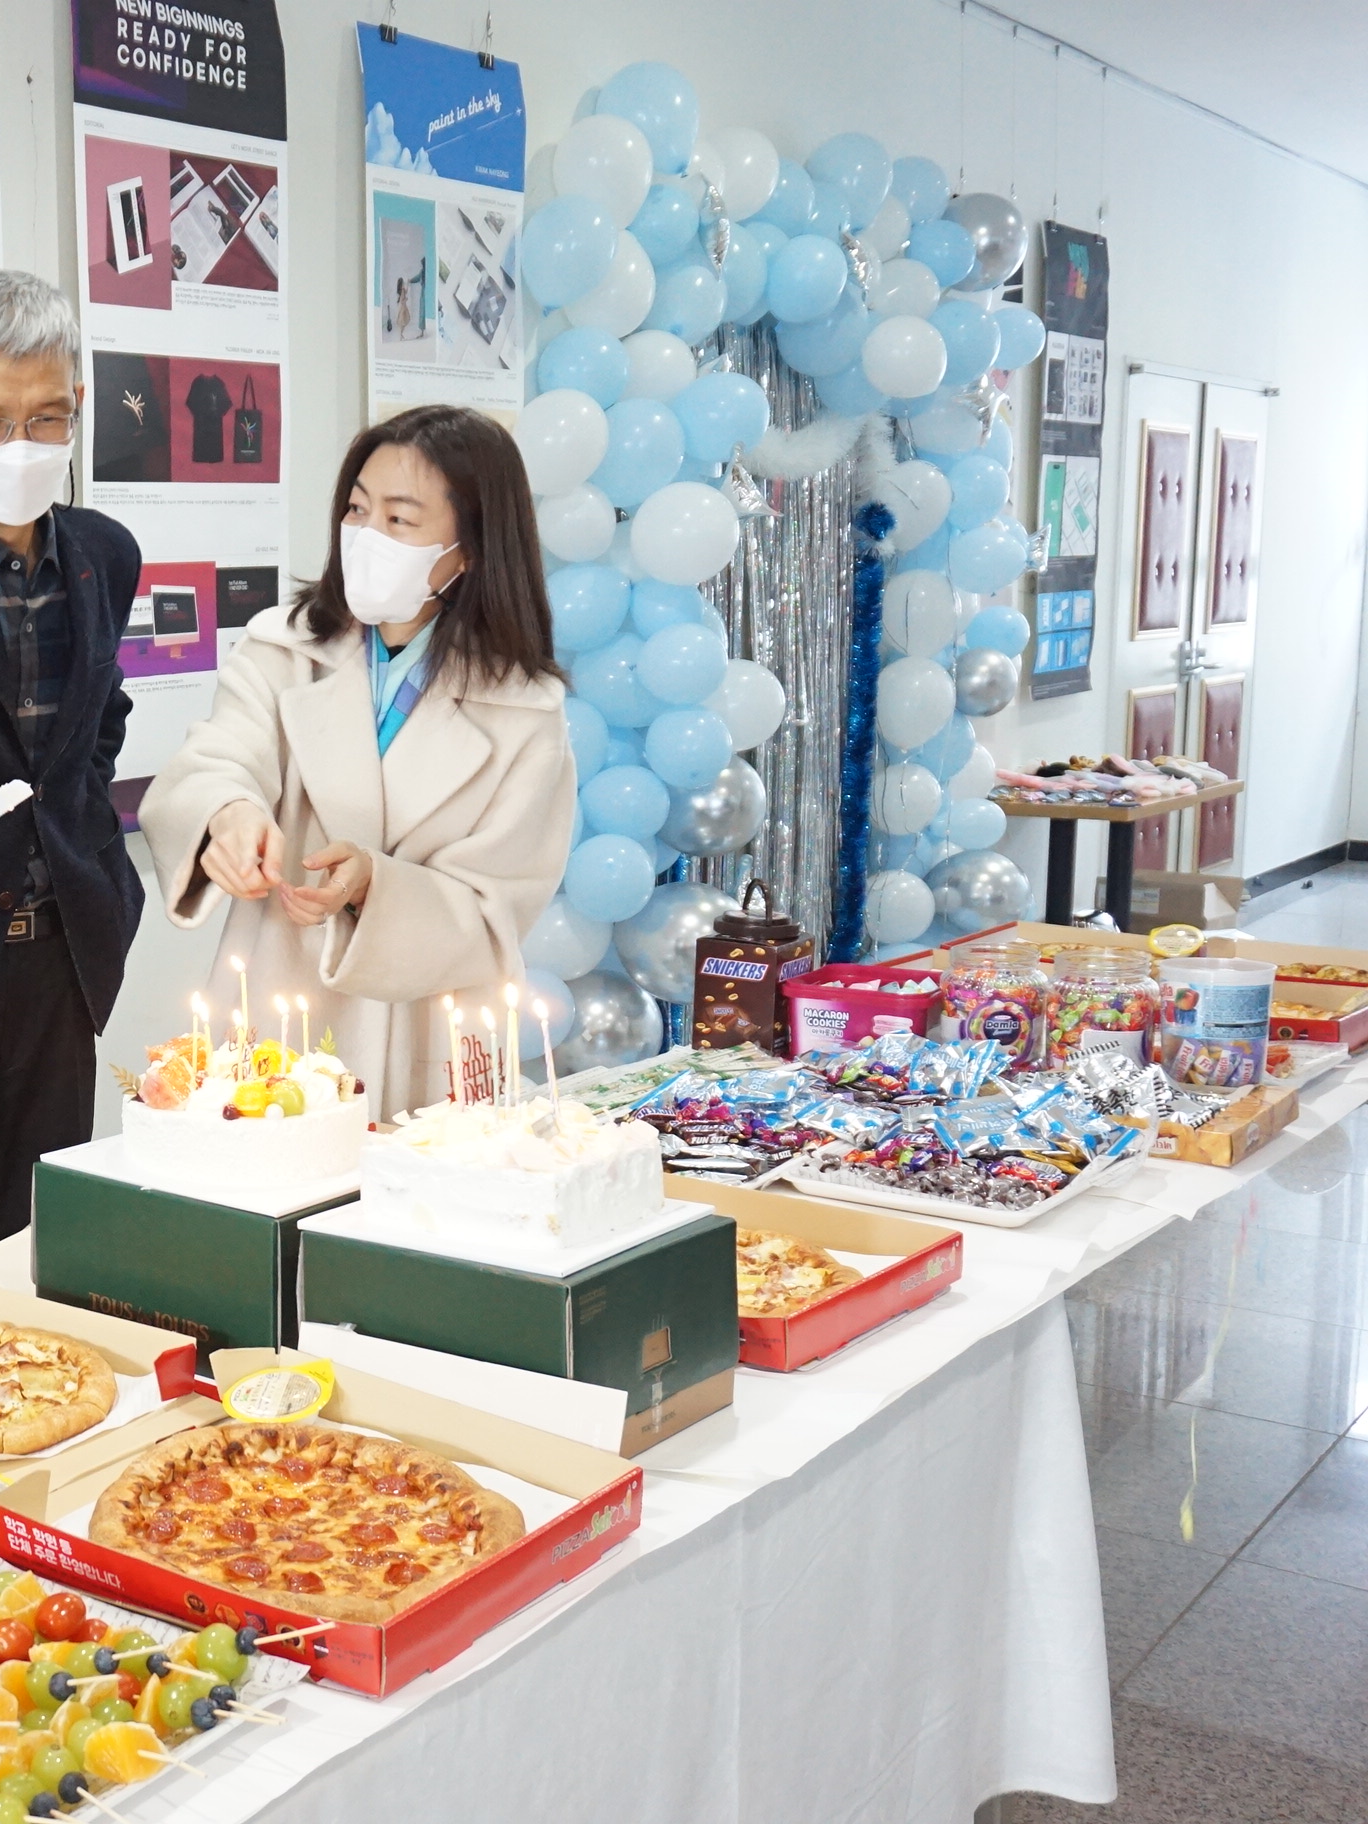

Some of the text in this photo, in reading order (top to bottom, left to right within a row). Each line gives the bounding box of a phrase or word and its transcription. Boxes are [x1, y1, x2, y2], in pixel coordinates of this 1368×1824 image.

[116, 0, 246, 41] NEW BIGINNINGS
[117, 17, 247, 65] READY FOR
[117, 44, 247, 90] CONFIDENCE
[427, 88, 502, 143] paint in the sky
[703, 958, 766, 980] SNICKERS
[780, 956, 811, 981] SNICKERS
[804, 1008, 849, 1020] MACARON
[807, 1018, 846, 1029] COOKIES
[986, 1020, 1019, 1029] Damla
[691, 1135, 729, 1145] FUN SIZE
[89, 1291, 134, 1320] TOUS
[3, 1515, 73, 1556] 학교, 학원 등
[7, 1533, 125, 1591] 단체 주문 환영합니다.
